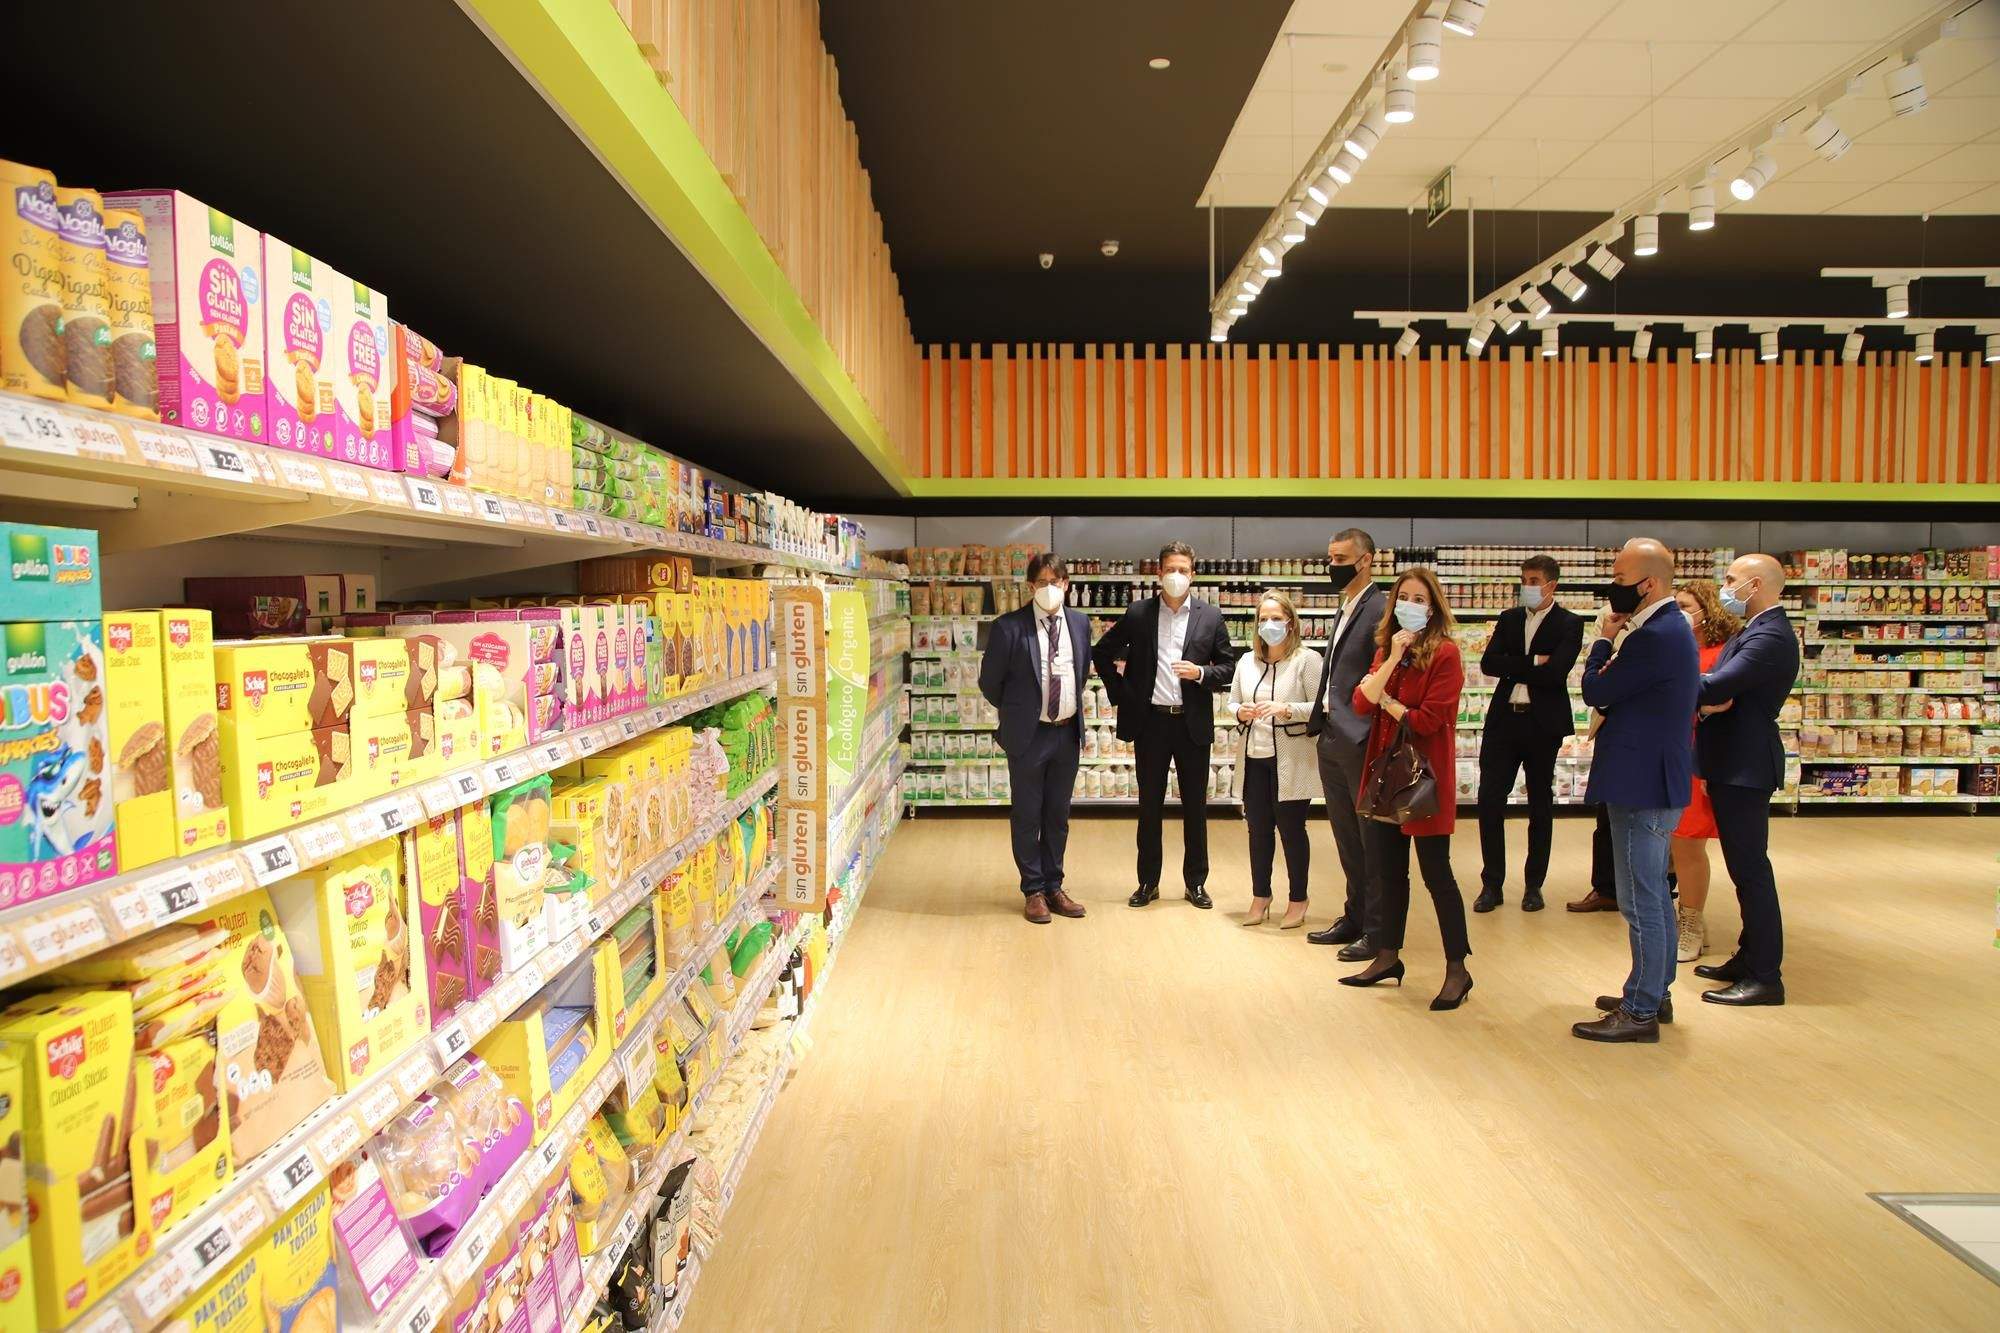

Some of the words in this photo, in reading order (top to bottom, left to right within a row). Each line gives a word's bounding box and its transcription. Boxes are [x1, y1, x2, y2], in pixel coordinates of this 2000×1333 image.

[789, 605, 813, 669] gluten
[838, 607, 858, 672] Organic
[797, 673, 807, 692] sin
[793, 709, 813, 773] gluten
[838, 685, 857, 762] Ecológico
[797, 776, 808, 796] sin
[792, 812, 812, 876] gluten
[796, 878, 806, 899] sin
[219, 910, 248, 931] Gluten
[273, 1227, 293, 1249] PAN
[294, 1191, 326, 1228] TOSTADO
[290, 1220, 318, 1255] TOSTAS
[194, 1299, 218, 1328] PAN
[218, 1256, 257, 1304] TOSTADO
[214, 1289, 249, 1333] TOSTAS
